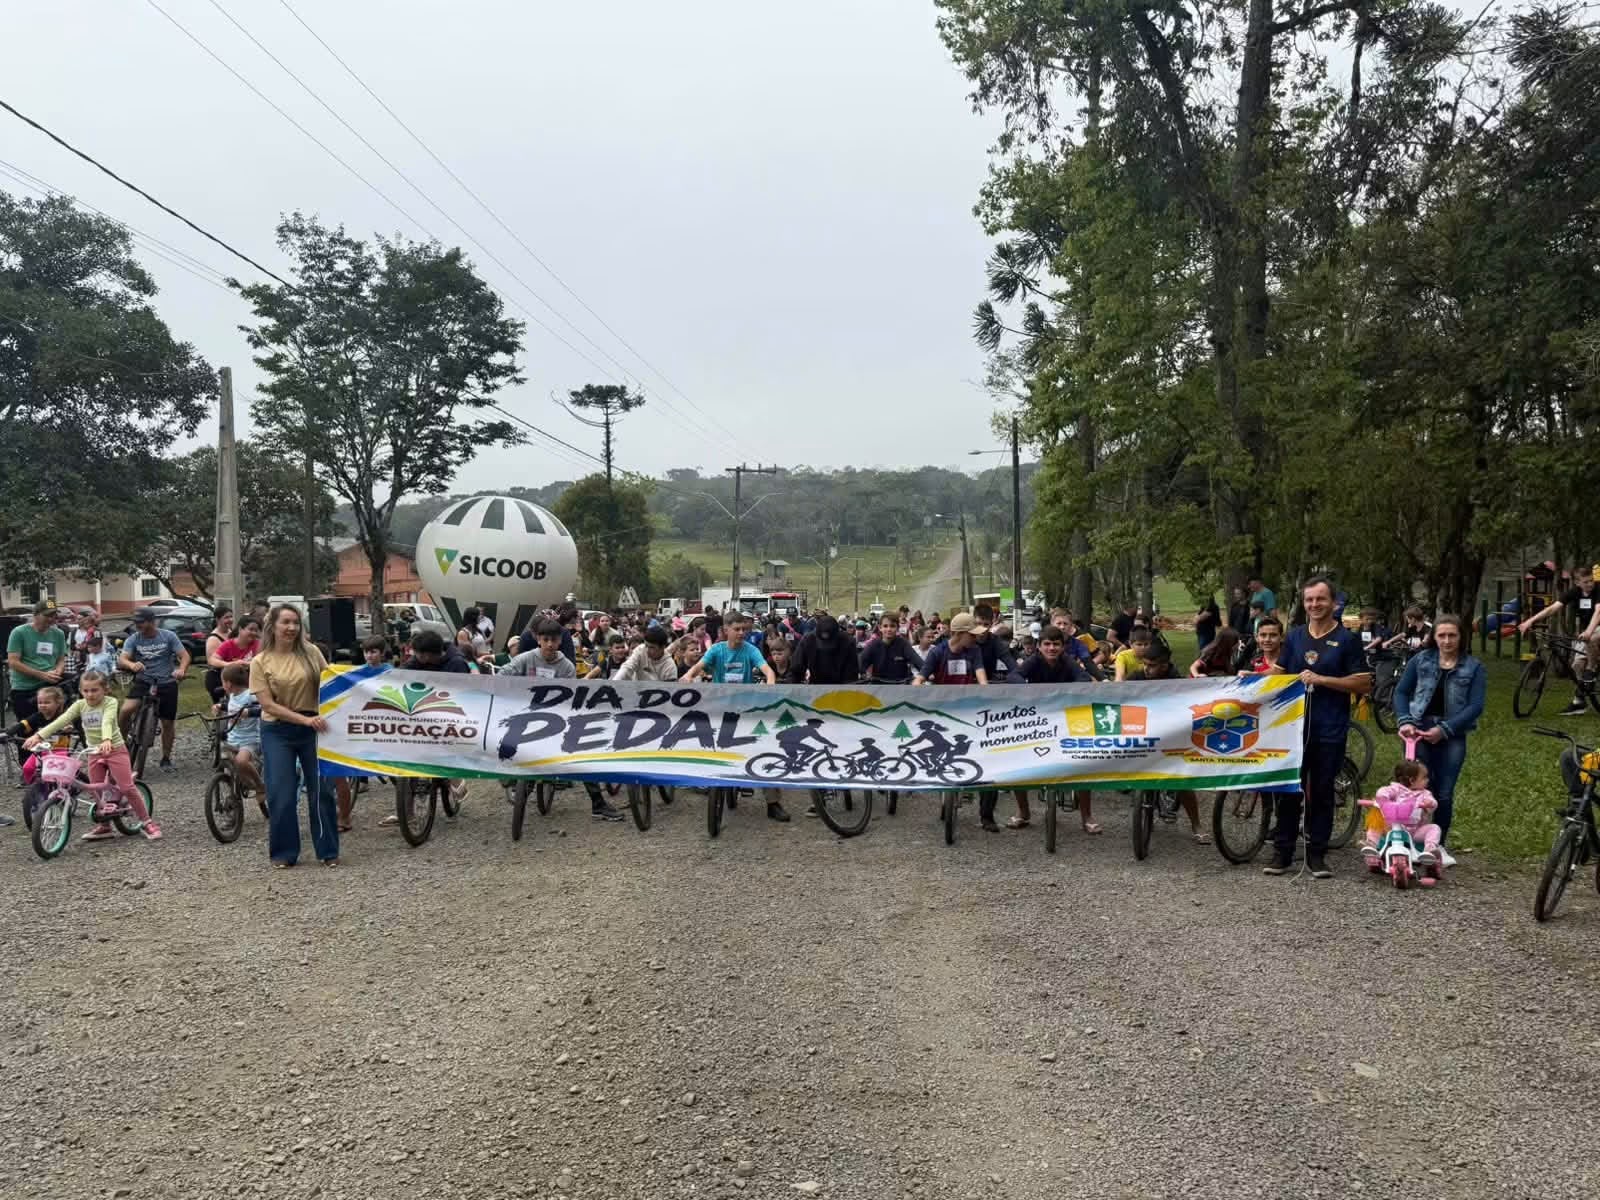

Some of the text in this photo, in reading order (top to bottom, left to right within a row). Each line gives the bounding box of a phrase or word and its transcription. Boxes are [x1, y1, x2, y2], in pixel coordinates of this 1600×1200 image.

[459, 554, 547, 580] SICOOB
[527, 685, 702, 711] DIA DO
[348, 714, 406, 722] SECRETARIA
[409, 717, 460, 725] MUNICIPAL
[976, 705, 1037, 727] Juntos
[986, 716, 1049, 738] por mais
[347, 722, 478, 739] EDUCAÇÃO
[497, 710, 758, 761] PEDAL
[980, 725, 1058, 748] momentos!
[1060, 737, 1161, 748] SECULT
